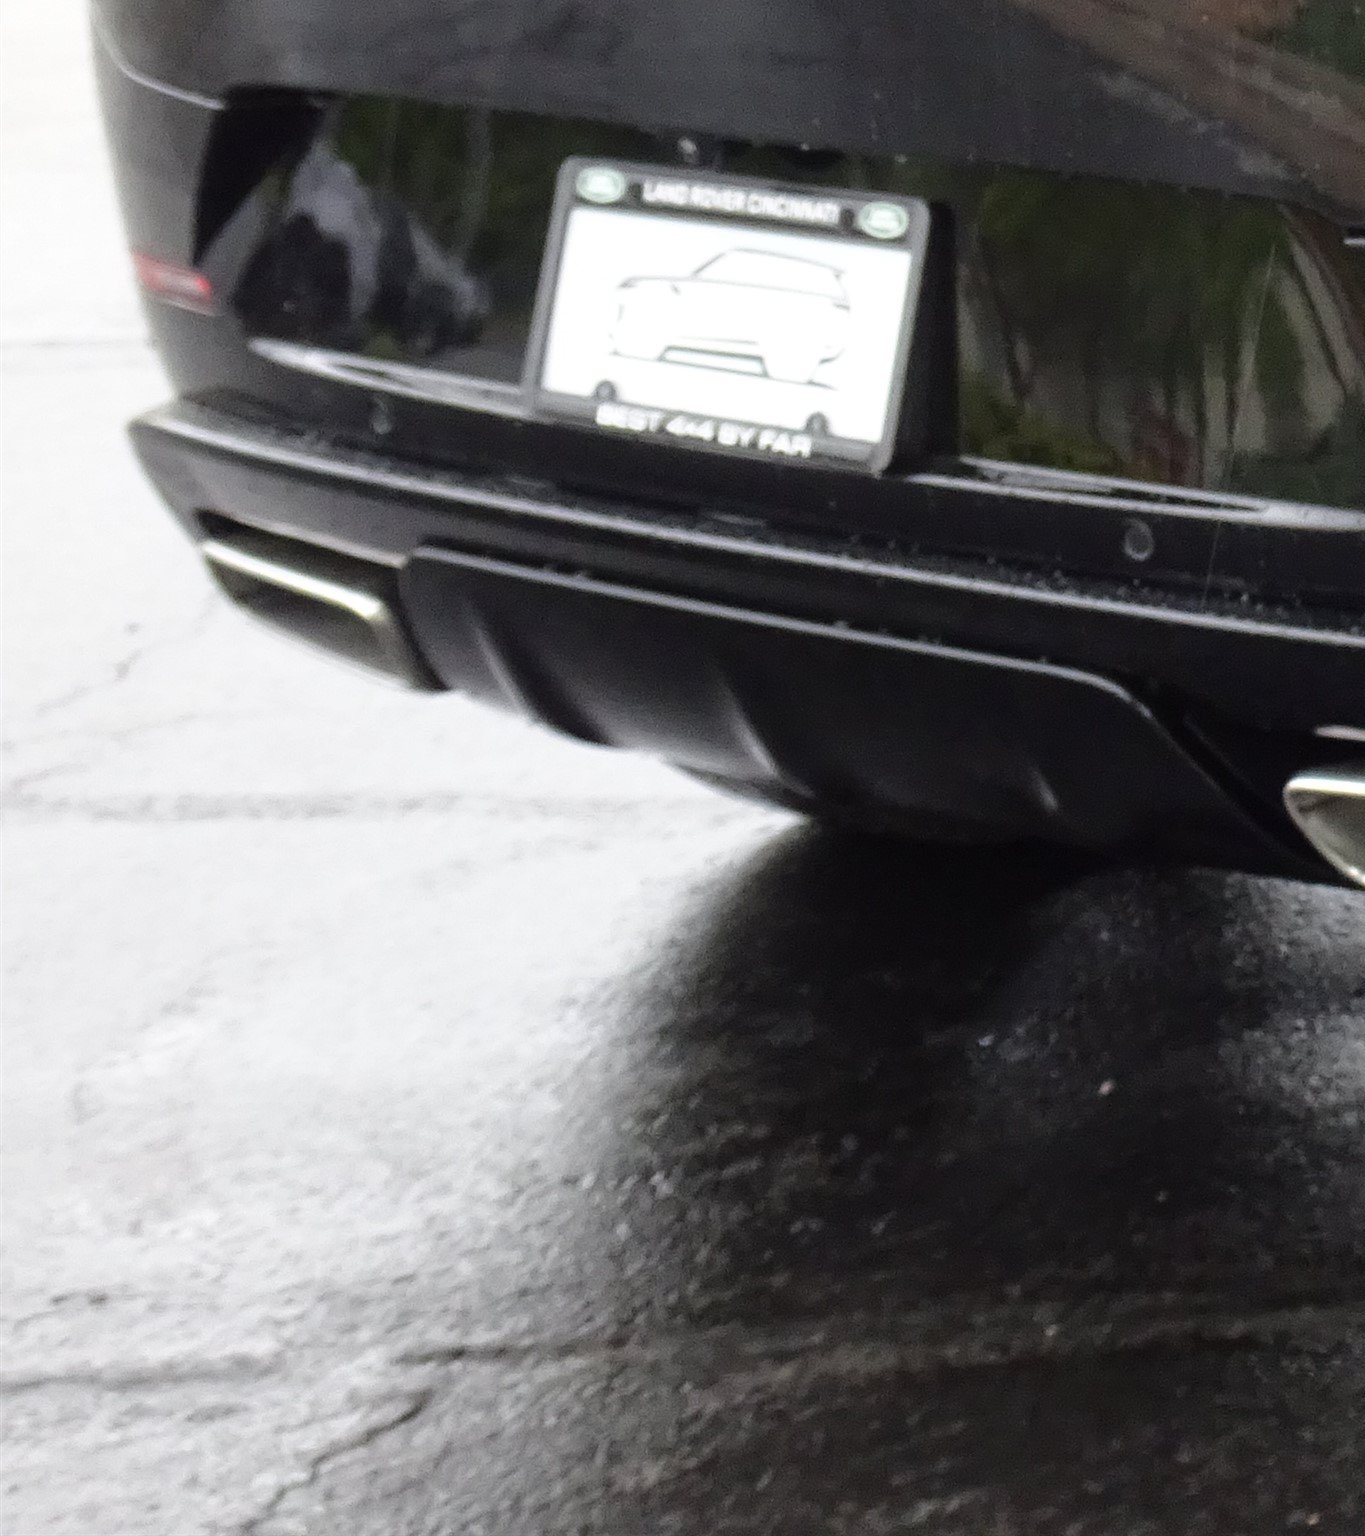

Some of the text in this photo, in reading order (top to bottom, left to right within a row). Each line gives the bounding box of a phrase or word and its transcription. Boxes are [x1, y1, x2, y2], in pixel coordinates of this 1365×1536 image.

[690, 184, 747, 213] ROVER
[596, 402, 662, 433] BEST
[717, 420, 756, 448] BY
[758, 428, 812, 459] FAR
